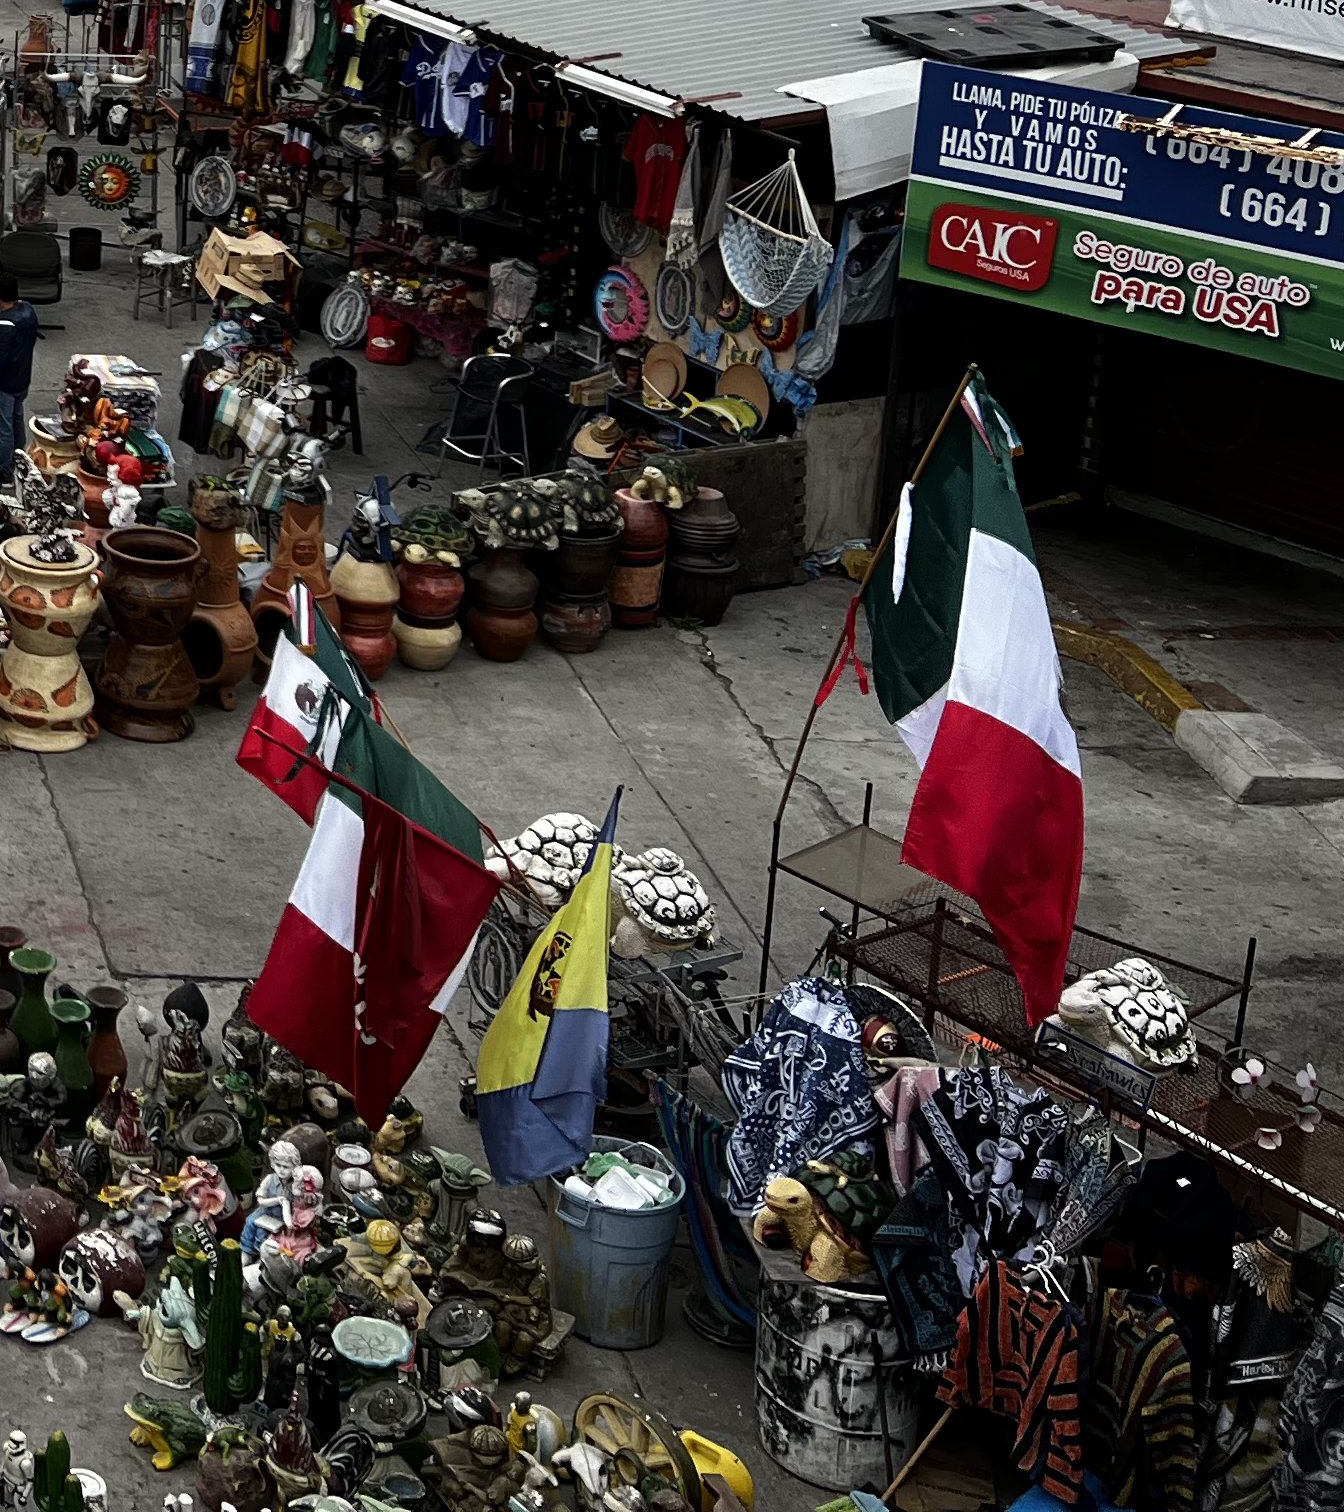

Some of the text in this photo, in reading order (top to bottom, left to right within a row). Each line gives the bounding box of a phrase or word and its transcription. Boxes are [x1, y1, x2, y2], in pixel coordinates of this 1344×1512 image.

[952, 81, 1068, 120] LLAMA, PIDE TU
[975, 108, 1098, 150] Y VAMOS
[940, 125, 1128, 189] HASTA TU AUTO:
[1219, 183, 1332, 236] (664)
[940, 214, 1042, 269] CAIC
[1073, 230, 1310, 307] Seguro de auto
[976, 258, 1031, 282] Seguros USA
[1090, 269, 1281, 337] para USA
